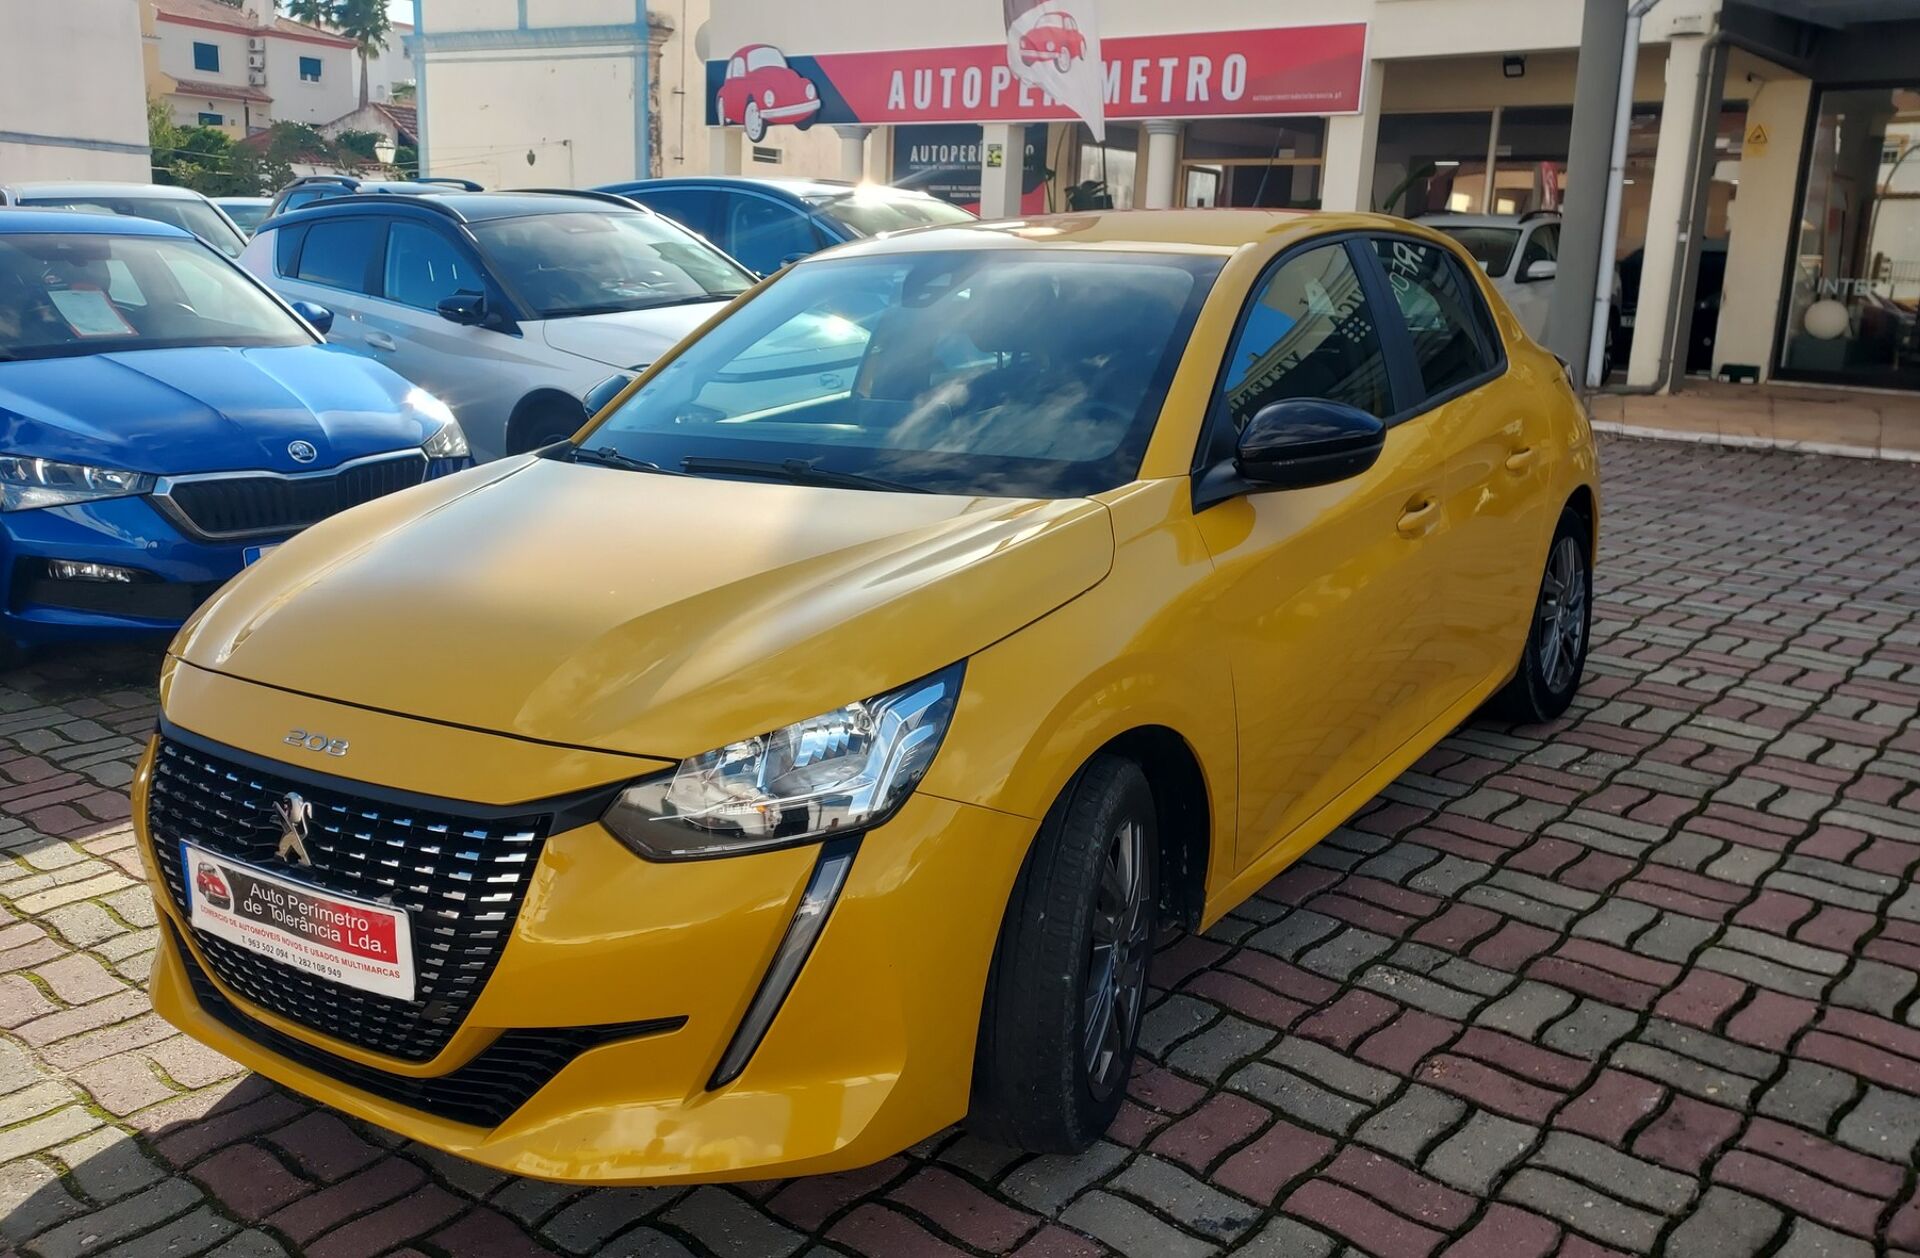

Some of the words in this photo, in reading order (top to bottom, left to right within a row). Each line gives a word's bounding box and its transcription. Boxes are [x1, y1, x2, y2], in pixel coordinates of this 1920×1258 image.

[283, 728, 350, 756] 208
[243, 898, 263, 915] de
[267, 903, 341, 942] Tolerância
[348, 930, 388, 954] Lda.
[250, 883, 284, 906] Auto
[288, 895, 369, 932] Perímetro
[248, 938, 260, 949] 963
[262, 942, 274, 953] 502
[275, 947, 288, 959] 094
[299, 957, 312, 968] 282
[313, 962, 326, 973] 108
[327, 966, 342, 978] 949
[310, 949, 340, 963] USADOS
[341, 958, 400, 978] MULTIMARCAS
